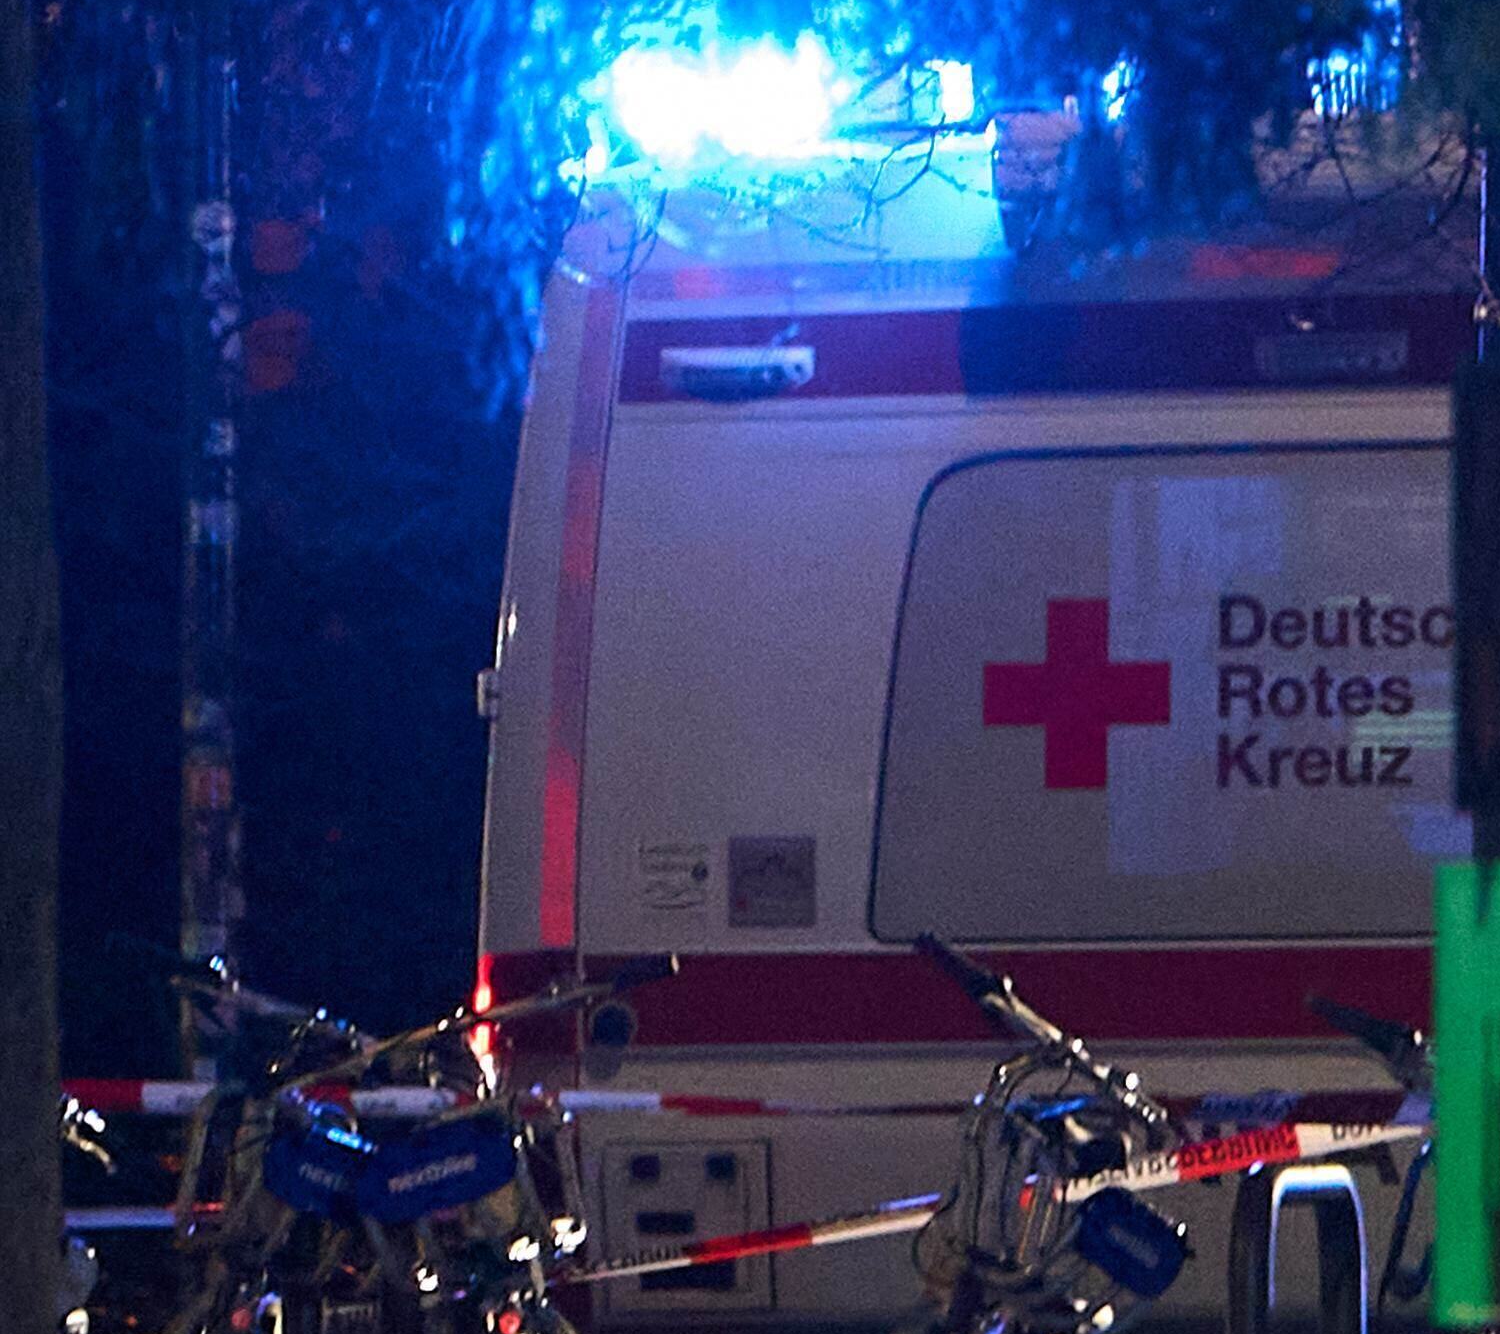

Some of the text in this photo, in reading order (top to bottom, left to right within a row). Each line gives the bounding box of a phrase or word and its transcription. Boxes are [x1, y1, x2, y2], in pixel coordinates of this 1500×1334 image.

[1218, 594, 1455, 649] Deutsc
[1216, 666, 1414, 717] Rotes
[1216, 733, 1414, 788] Kreuz
